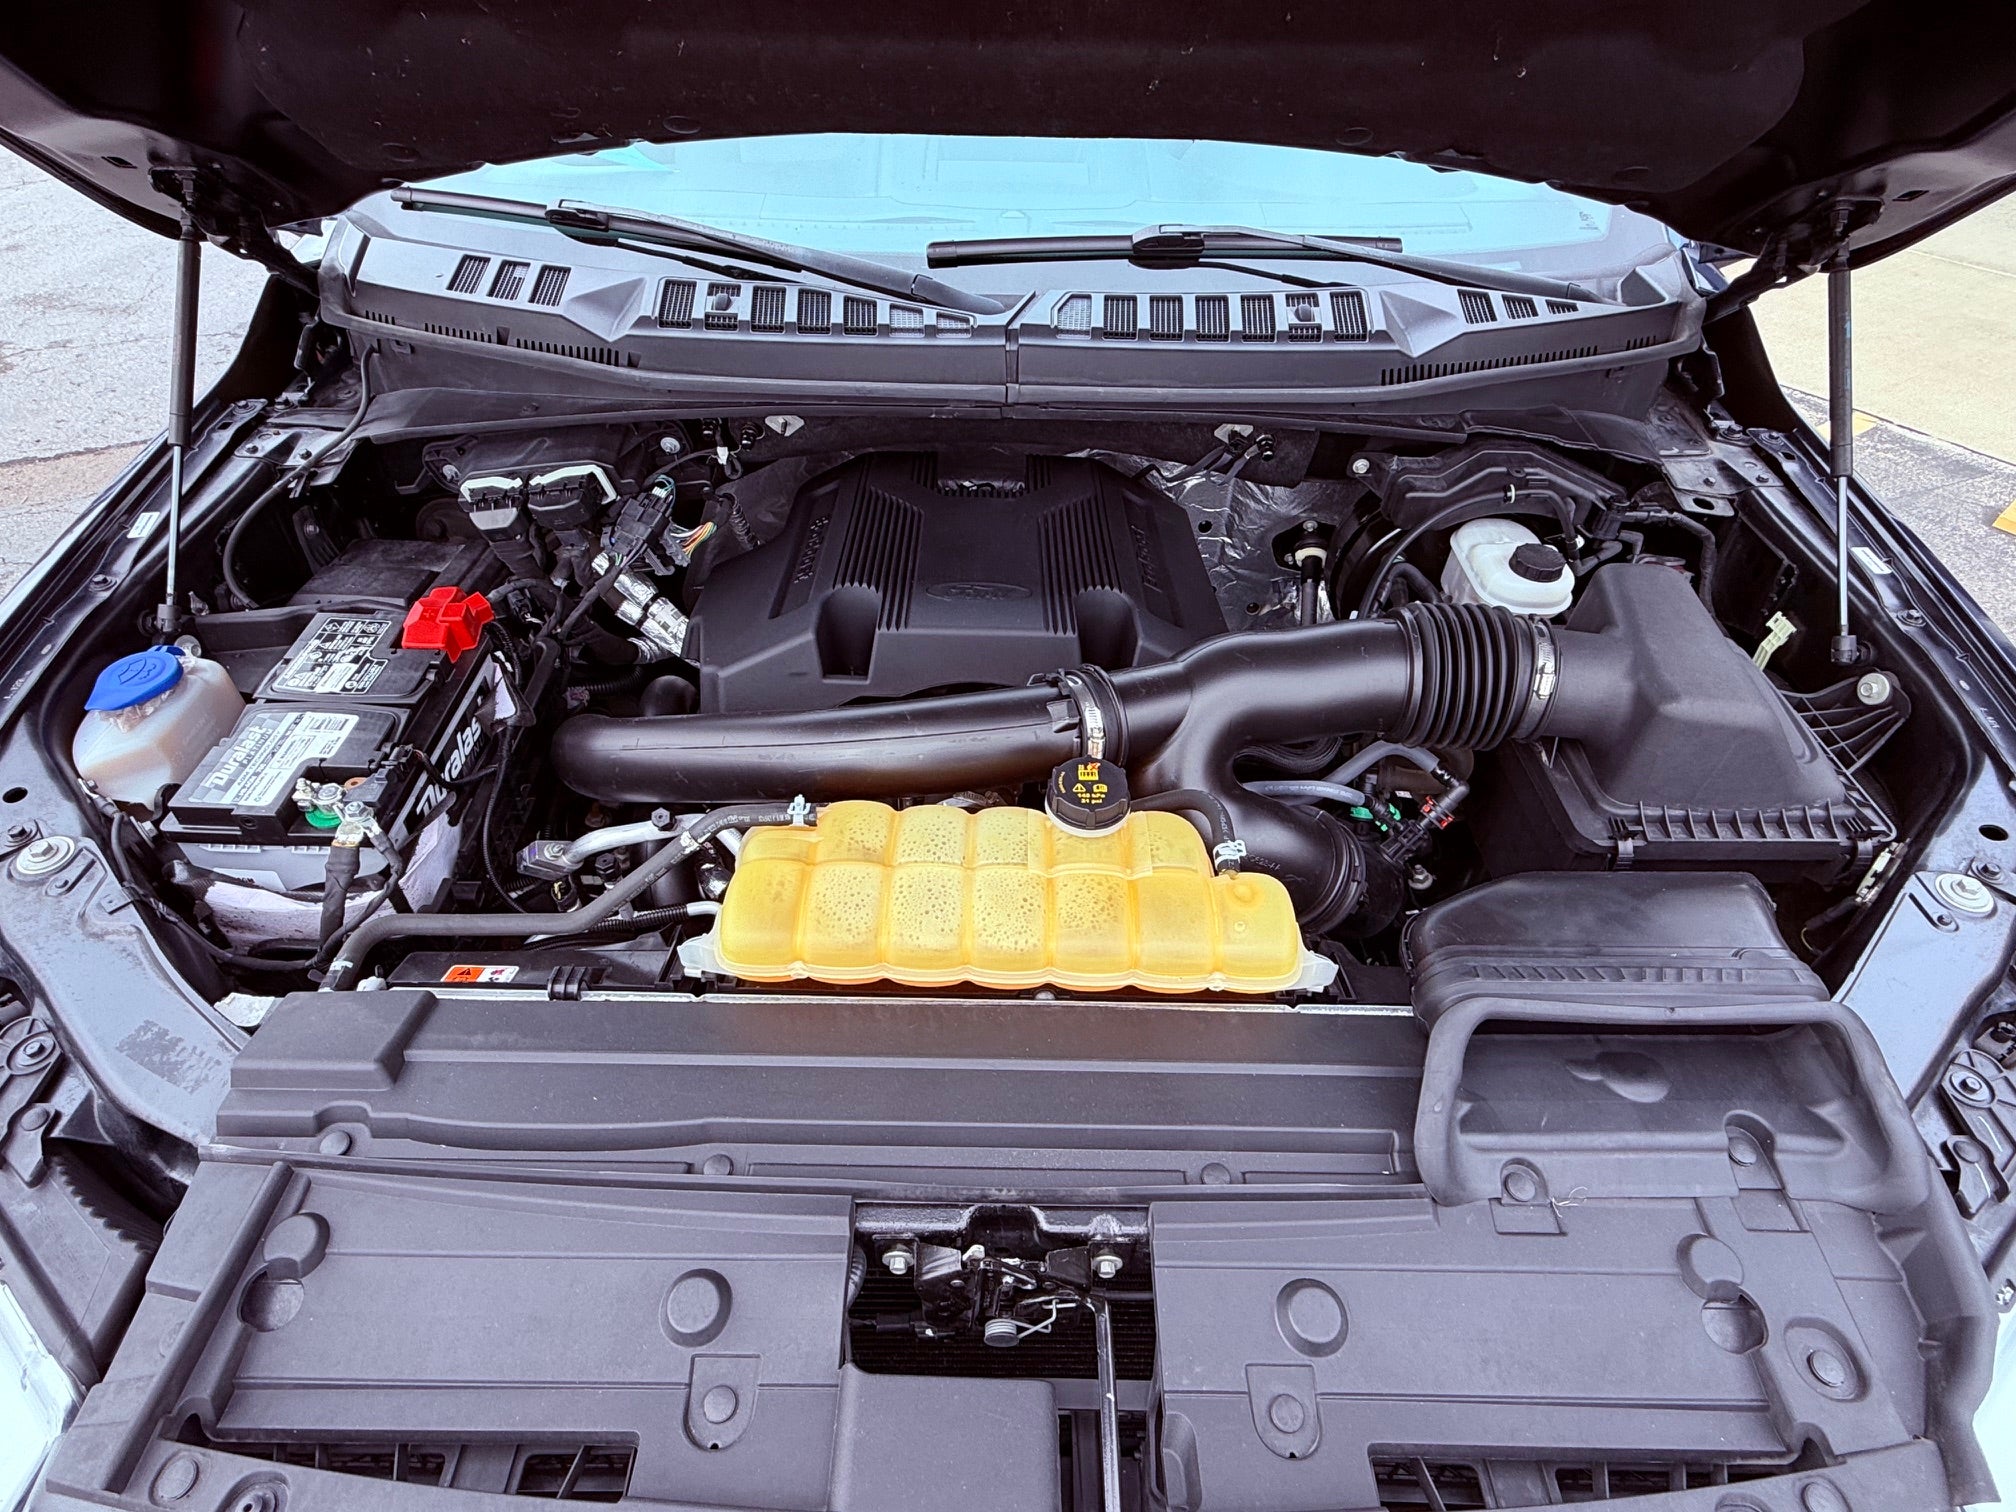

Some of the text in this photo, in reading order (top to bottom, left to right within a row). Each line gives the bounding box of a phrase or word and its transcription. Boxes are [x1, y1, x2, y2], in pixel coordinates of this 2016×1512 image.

[203, 725, 267, 787] Duralast
[242, 728, 274, 765] PLATINUM
[416, 695, 483, 816] Duralas
